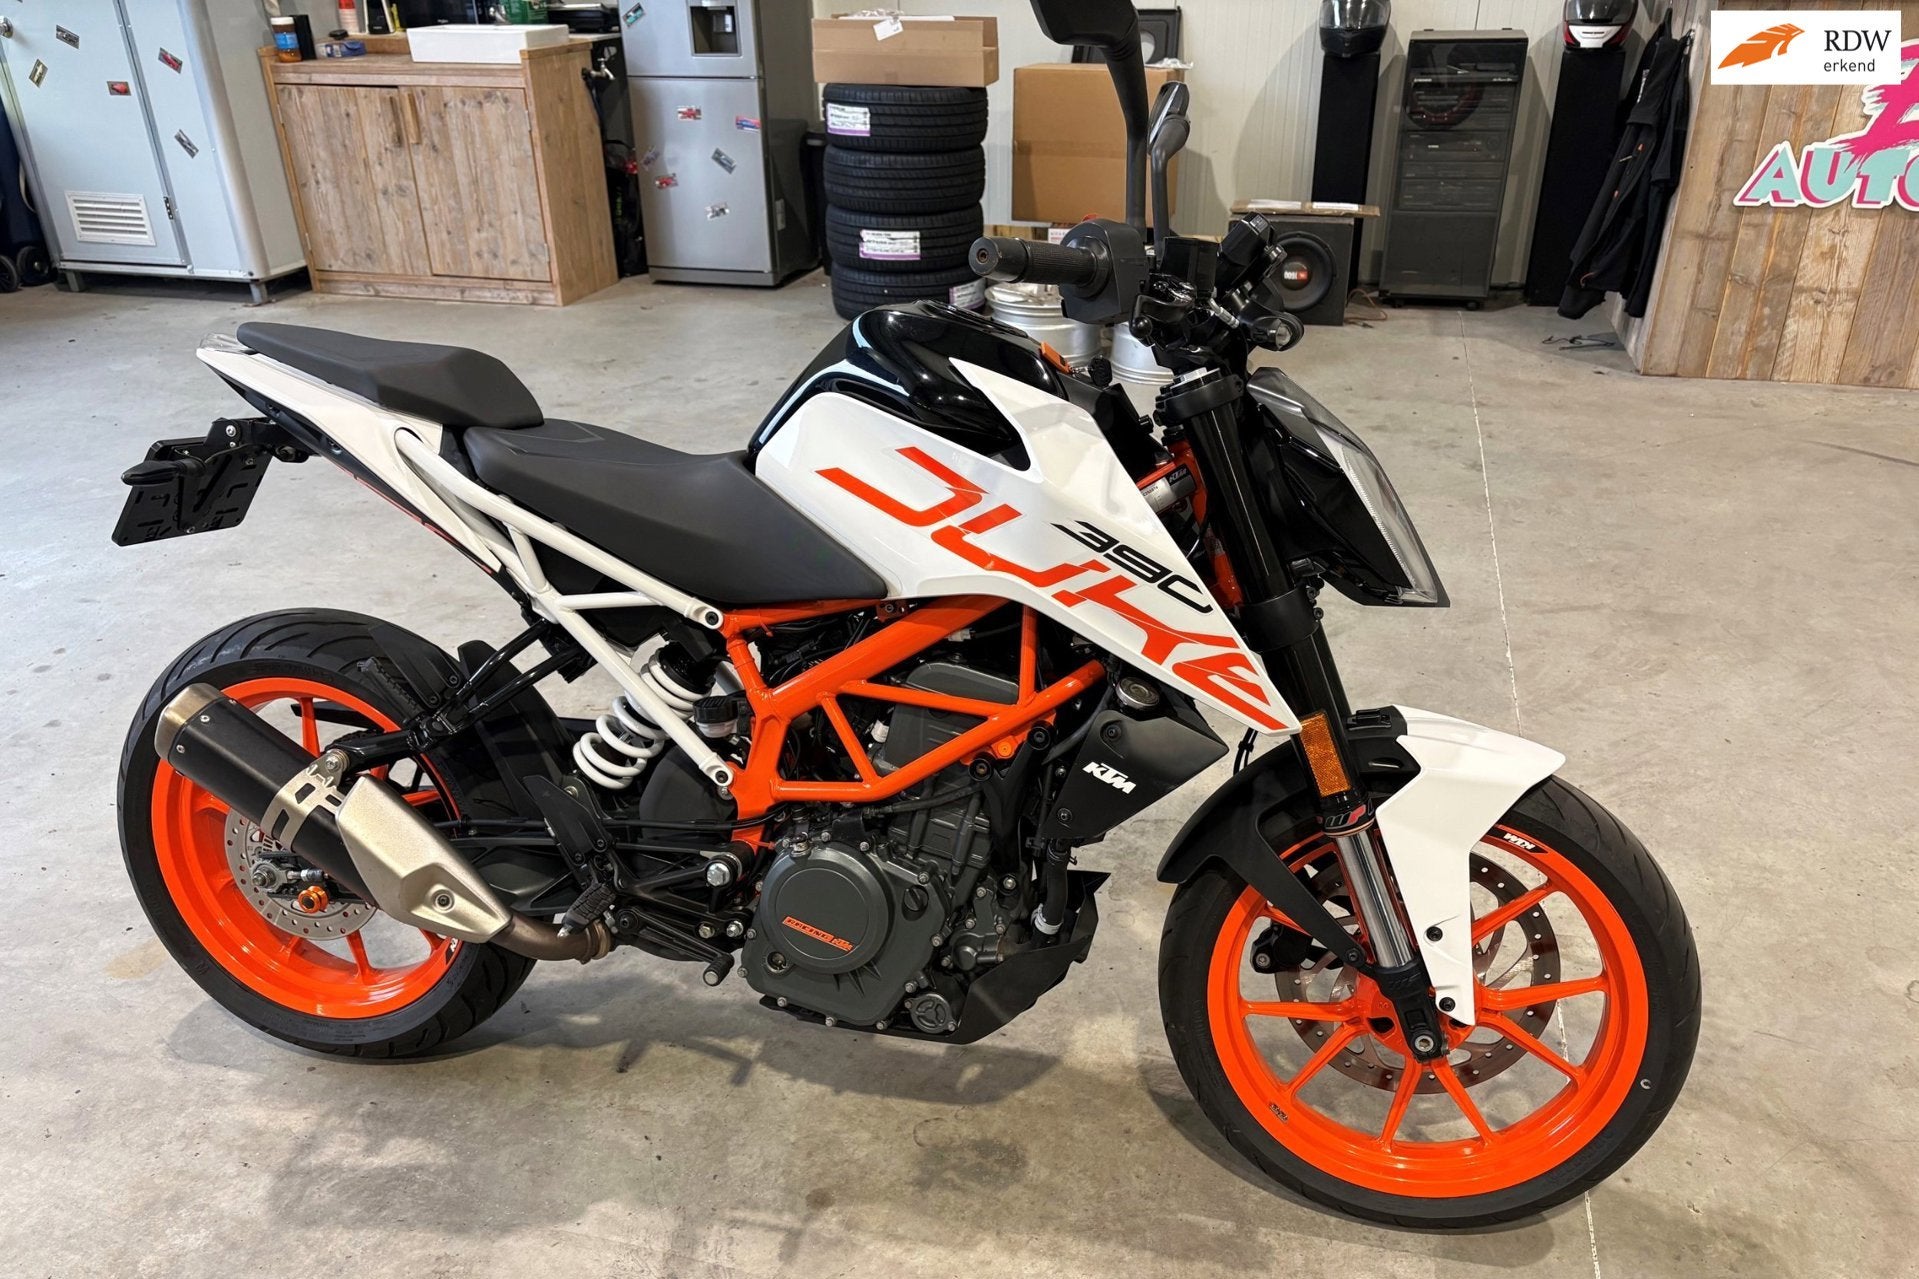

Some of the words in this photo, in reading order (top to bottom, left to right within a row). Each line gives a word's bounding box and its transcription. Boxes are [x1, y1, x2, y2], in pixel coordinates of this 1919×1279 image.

[815, 446, 1288, 730] DUKE
[1082, 761, 1137, 794] KTM
[1503, 833, 1536, 850] KTM
